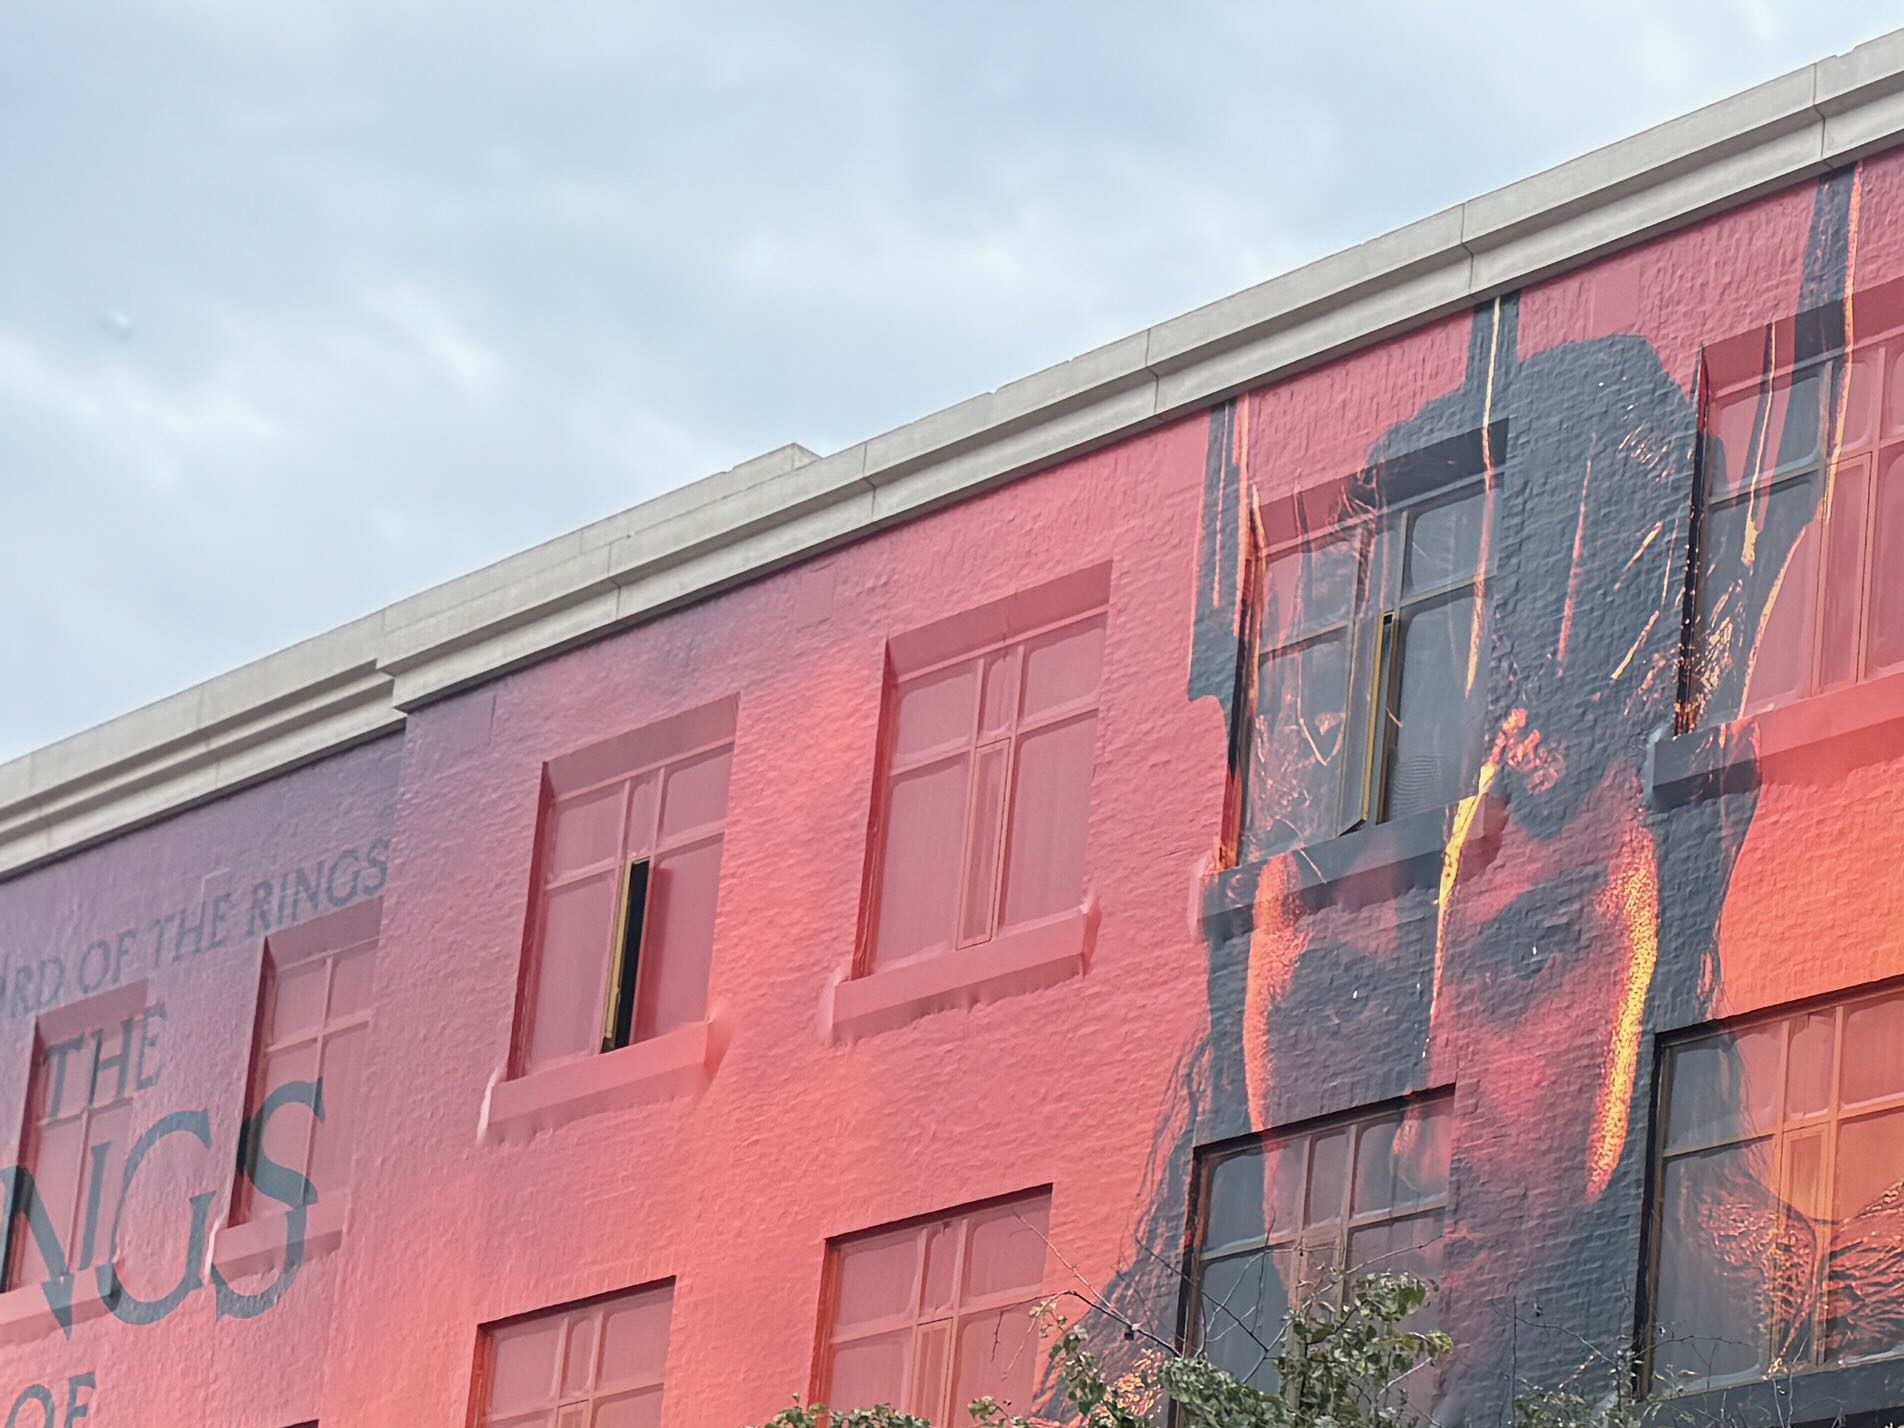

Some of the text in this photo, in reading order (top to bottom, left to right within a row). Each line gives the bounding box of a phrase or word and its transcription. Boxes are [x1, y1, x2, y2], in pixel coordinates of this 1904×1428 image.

[0, 838, 392, 1018] RD OF THE RINGS
[43, 1002, 168, 1122] THE
